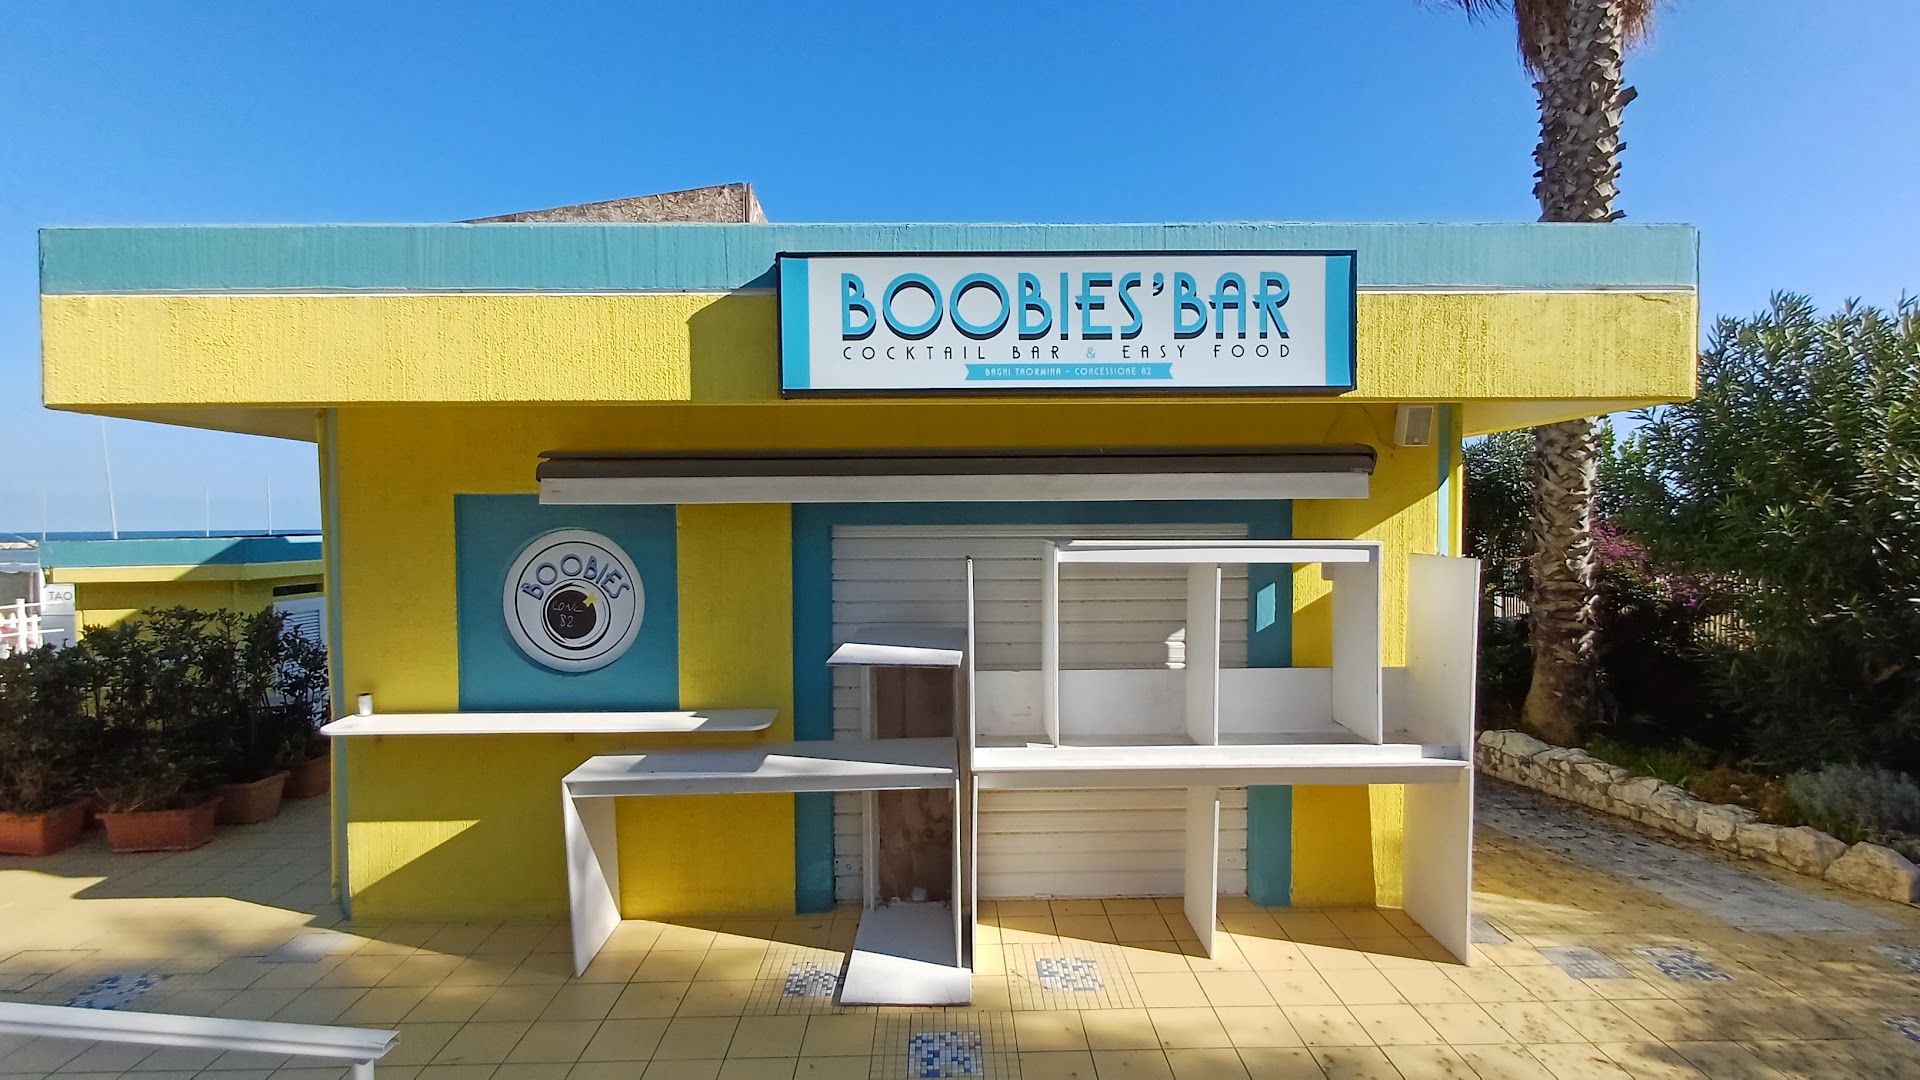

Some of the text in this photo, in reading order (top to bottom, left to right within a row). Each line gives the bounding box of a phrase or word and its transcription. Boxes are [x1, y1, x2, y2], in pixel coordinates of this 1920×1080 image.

[843, 344, 1290, 360] COCKTAIL BAR & EASY FOOD
[985, 367, 1011, 376] BAGNI
[1015, 367, 1062, 376] TAORMINA
[1074, 367, 1137, 376] CONCESSIONE
[1141, 367, 1152, 376] 82
[521, 553, 631, 600] BOOBIES
[48, 591, 73, 601] TAO
[559, 613, 575, 628] 82
